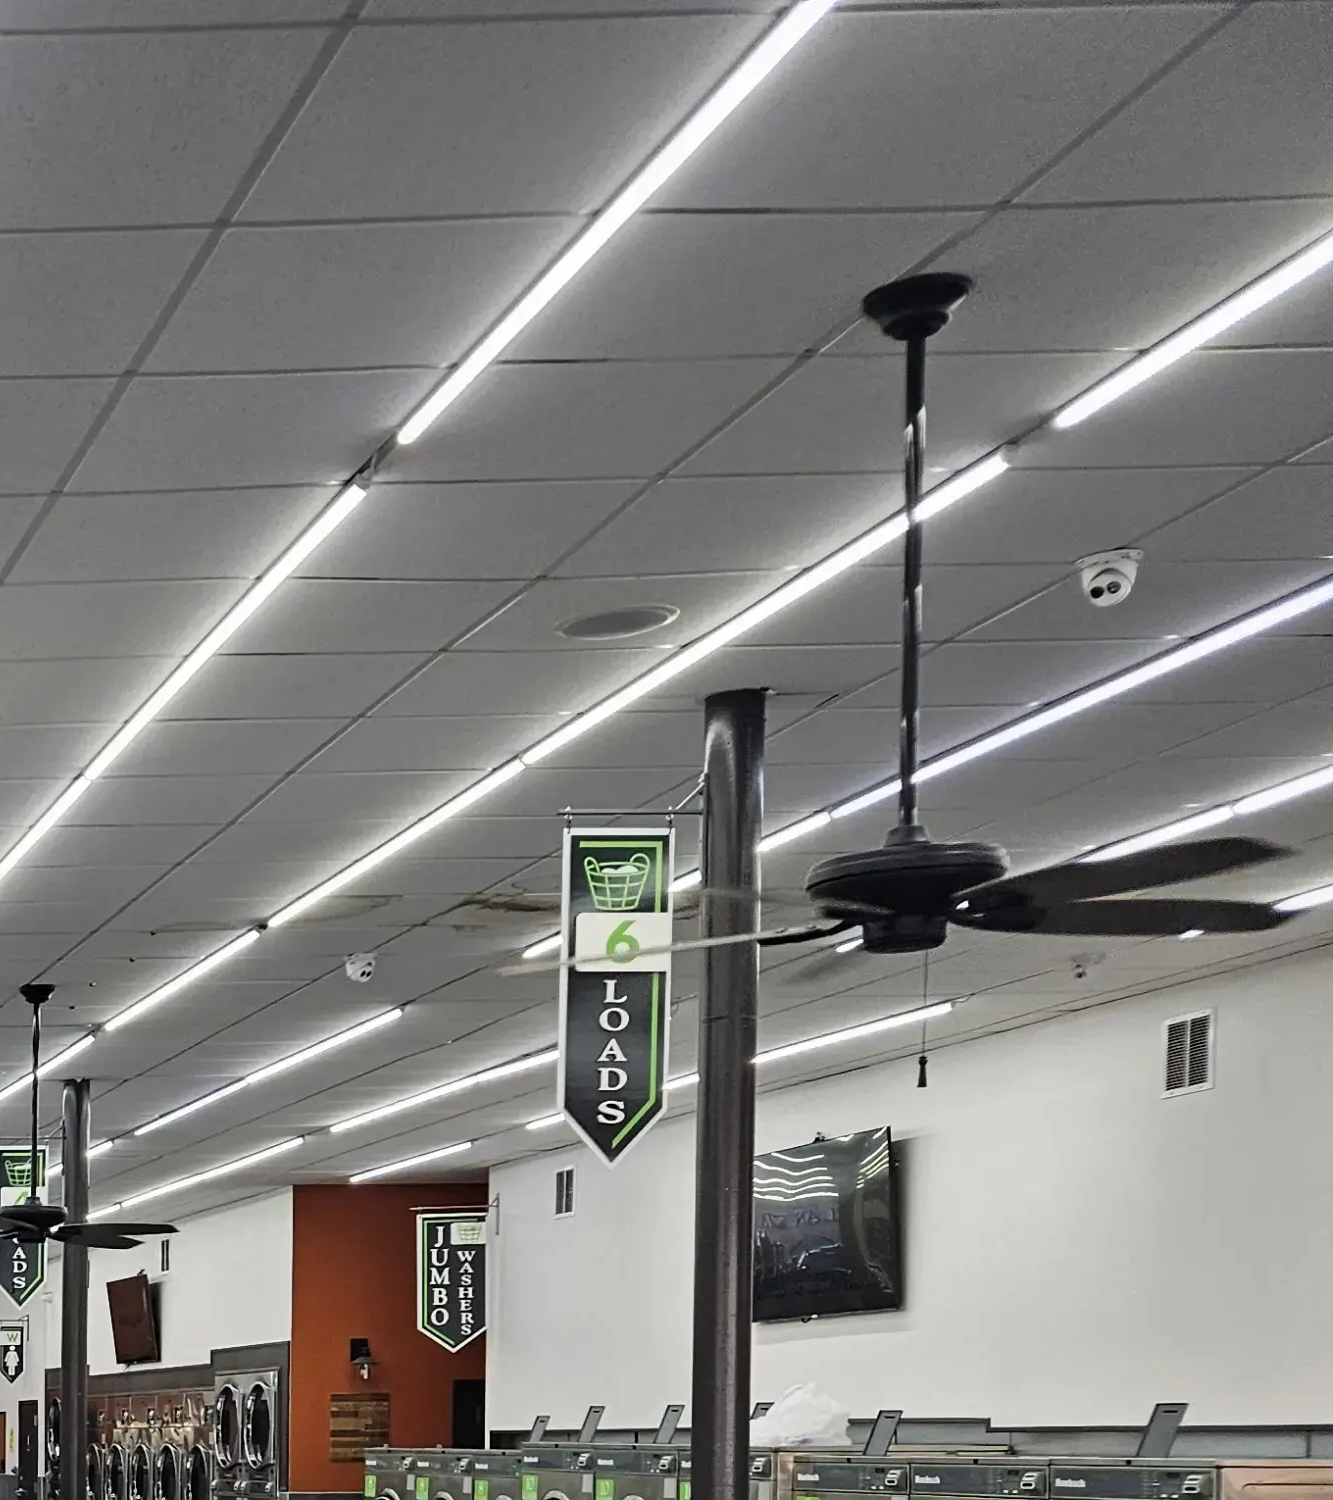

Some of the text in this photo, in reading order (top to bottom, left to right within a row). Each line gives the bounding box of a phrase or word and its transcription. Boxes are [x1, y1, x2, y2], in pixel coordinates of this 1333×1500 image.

[606, 920, 639, 964] 6
[597, 980, 630, 1125] LOADS
[12, 1238, 28, 1289] ADS
[429, 1226, 451, 1326] JUMBO
[456, 1250, 476, 1336] WASHERS
[6, 1332, 19, 1343] W
